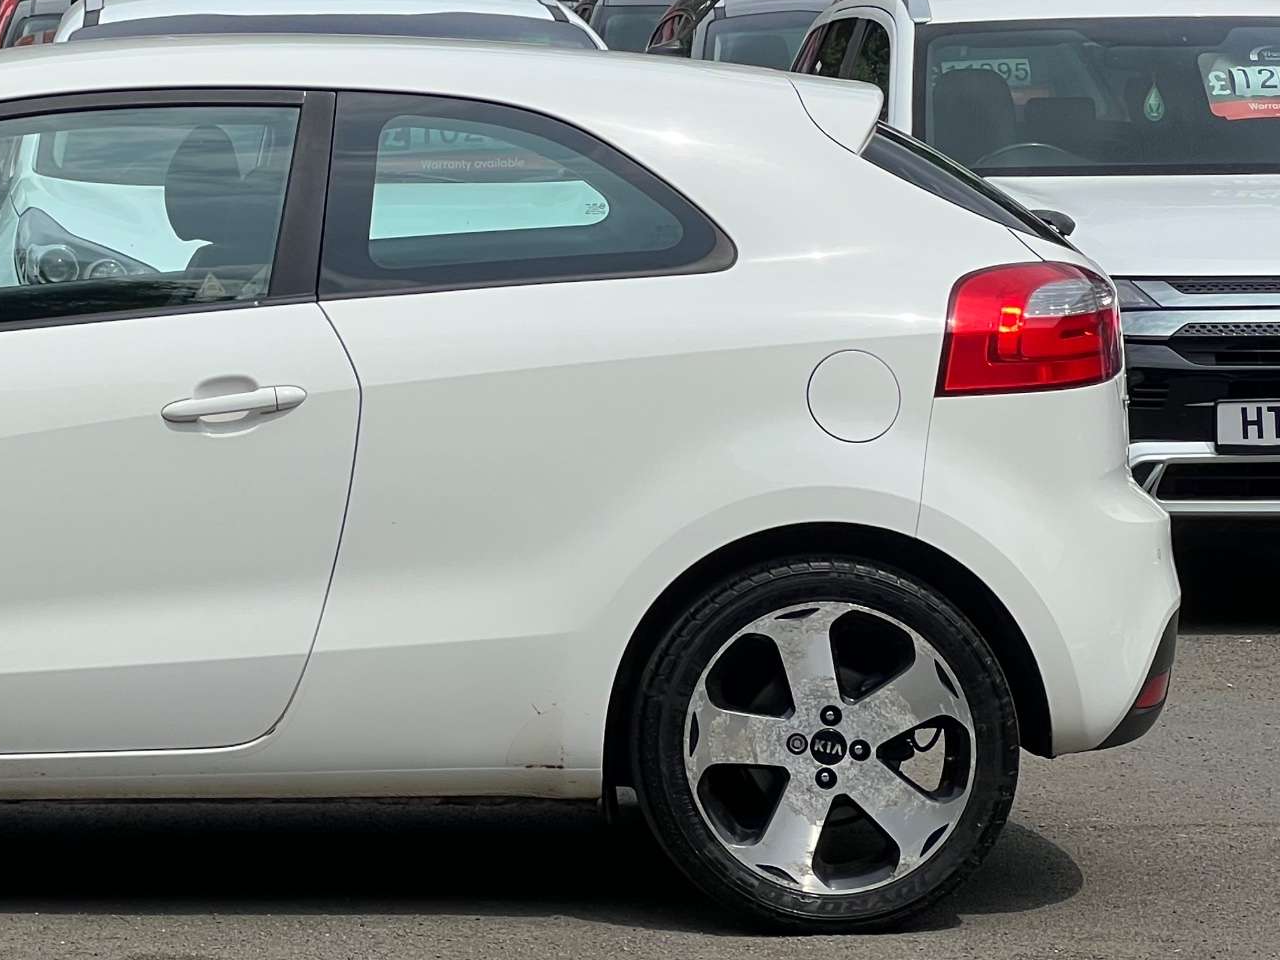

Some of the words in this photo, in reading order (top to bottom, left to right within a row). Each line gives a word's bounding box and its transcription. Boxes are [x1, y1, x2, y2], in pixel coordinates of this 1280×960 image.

[421, 159, 471, 171] Warranty
[474, 156, 525, 169] available
[1241, 406, 1280, 440] HT
[813, 739, 843, 757] KIA
